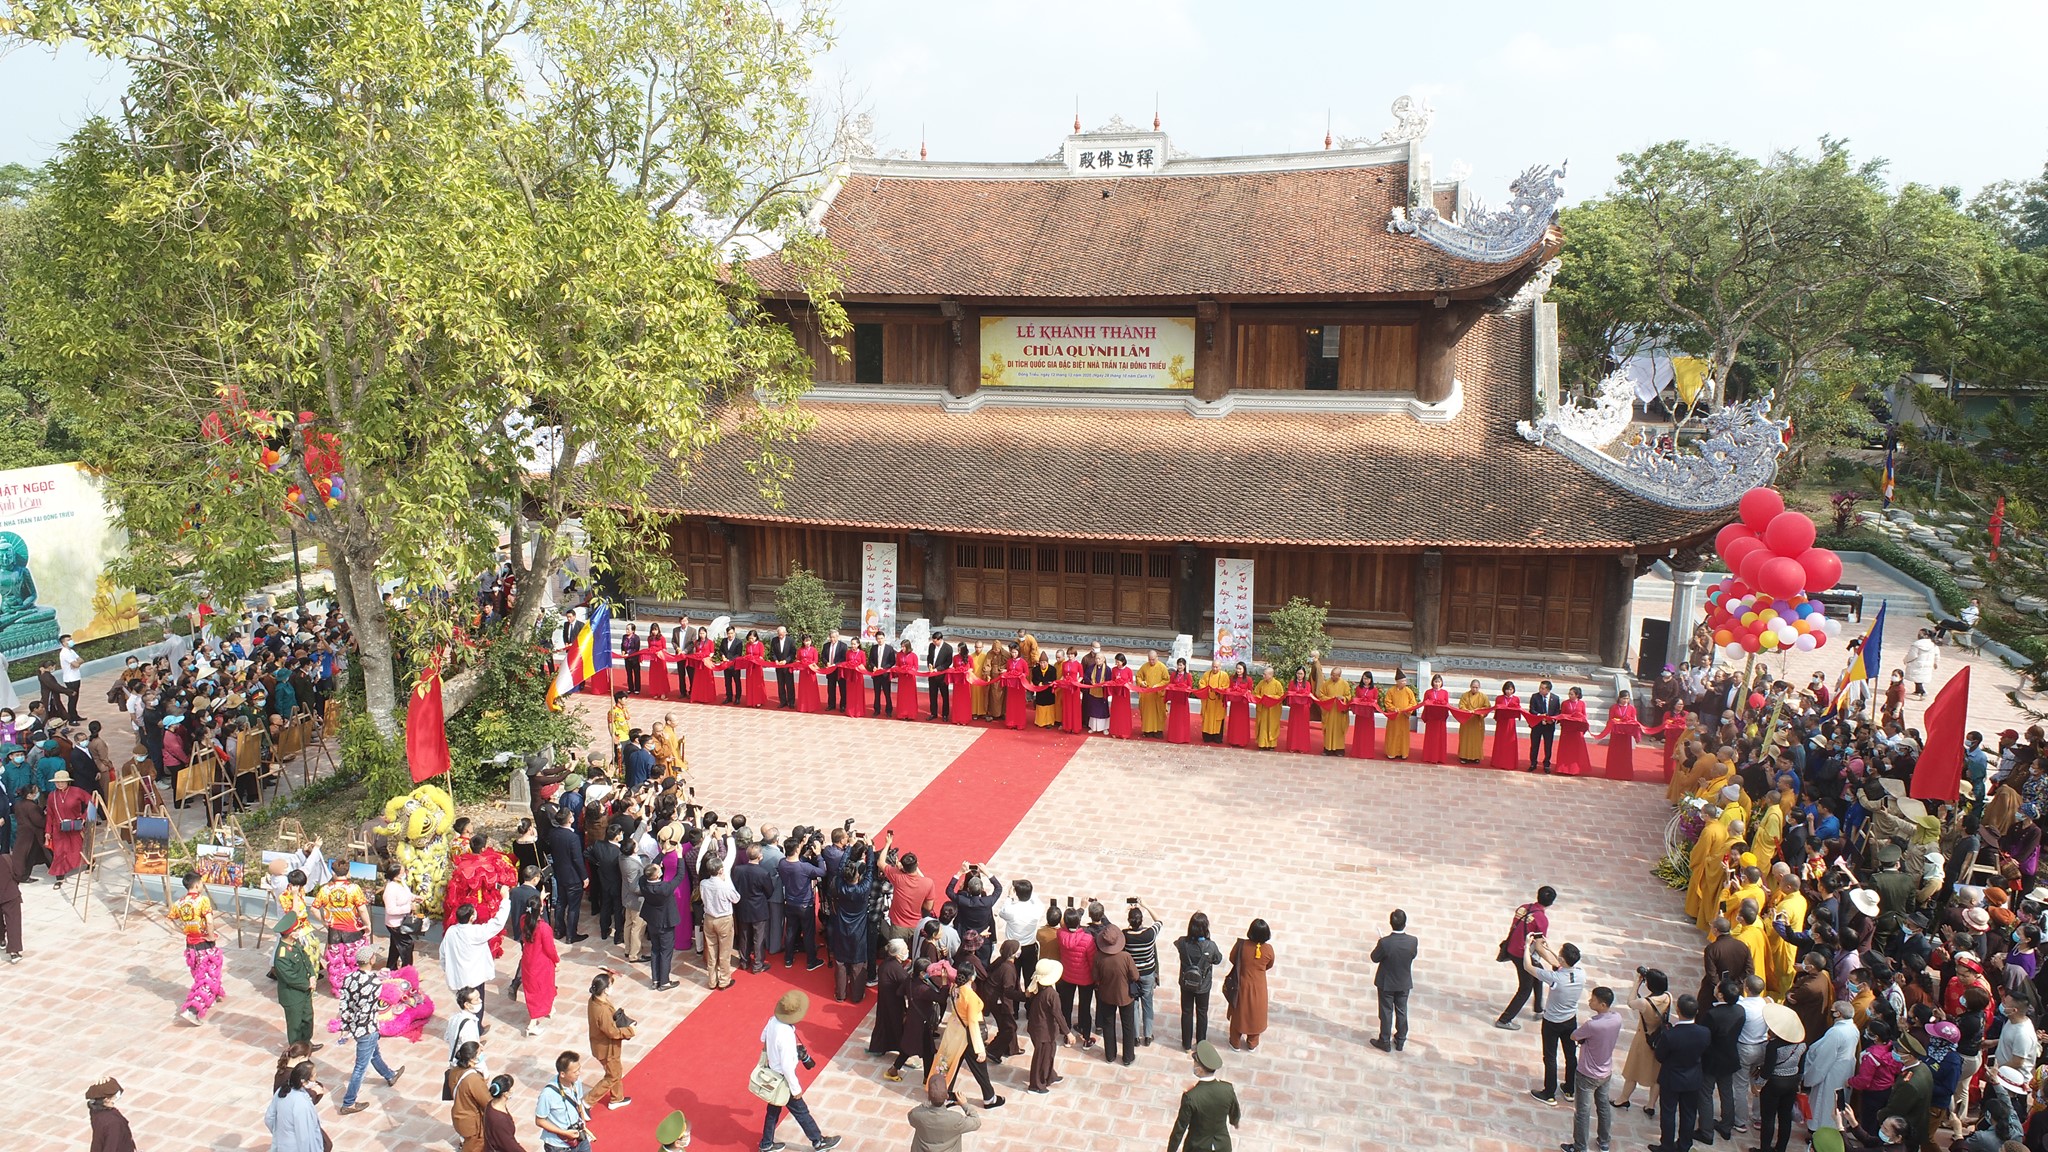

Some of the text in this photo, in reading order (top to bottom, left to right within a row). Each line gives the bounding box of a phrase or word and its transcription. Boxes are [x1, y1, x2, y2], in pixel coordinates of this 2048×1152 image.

[1039, 324, 1096, 341] KHÁNH
[1100, 324, 1157, 339] THÀNH
[1023, 343, 1150, 357] CHÙA QUỲNH LÂM
[1007, 358, 1166, 371] DI TÍCH QUỐC GIA ĐẶC BIỆT NHÀ TRẦN TẠI ĐÔNG TRIỀU
[23, 480, 56, 494] NGỌC
